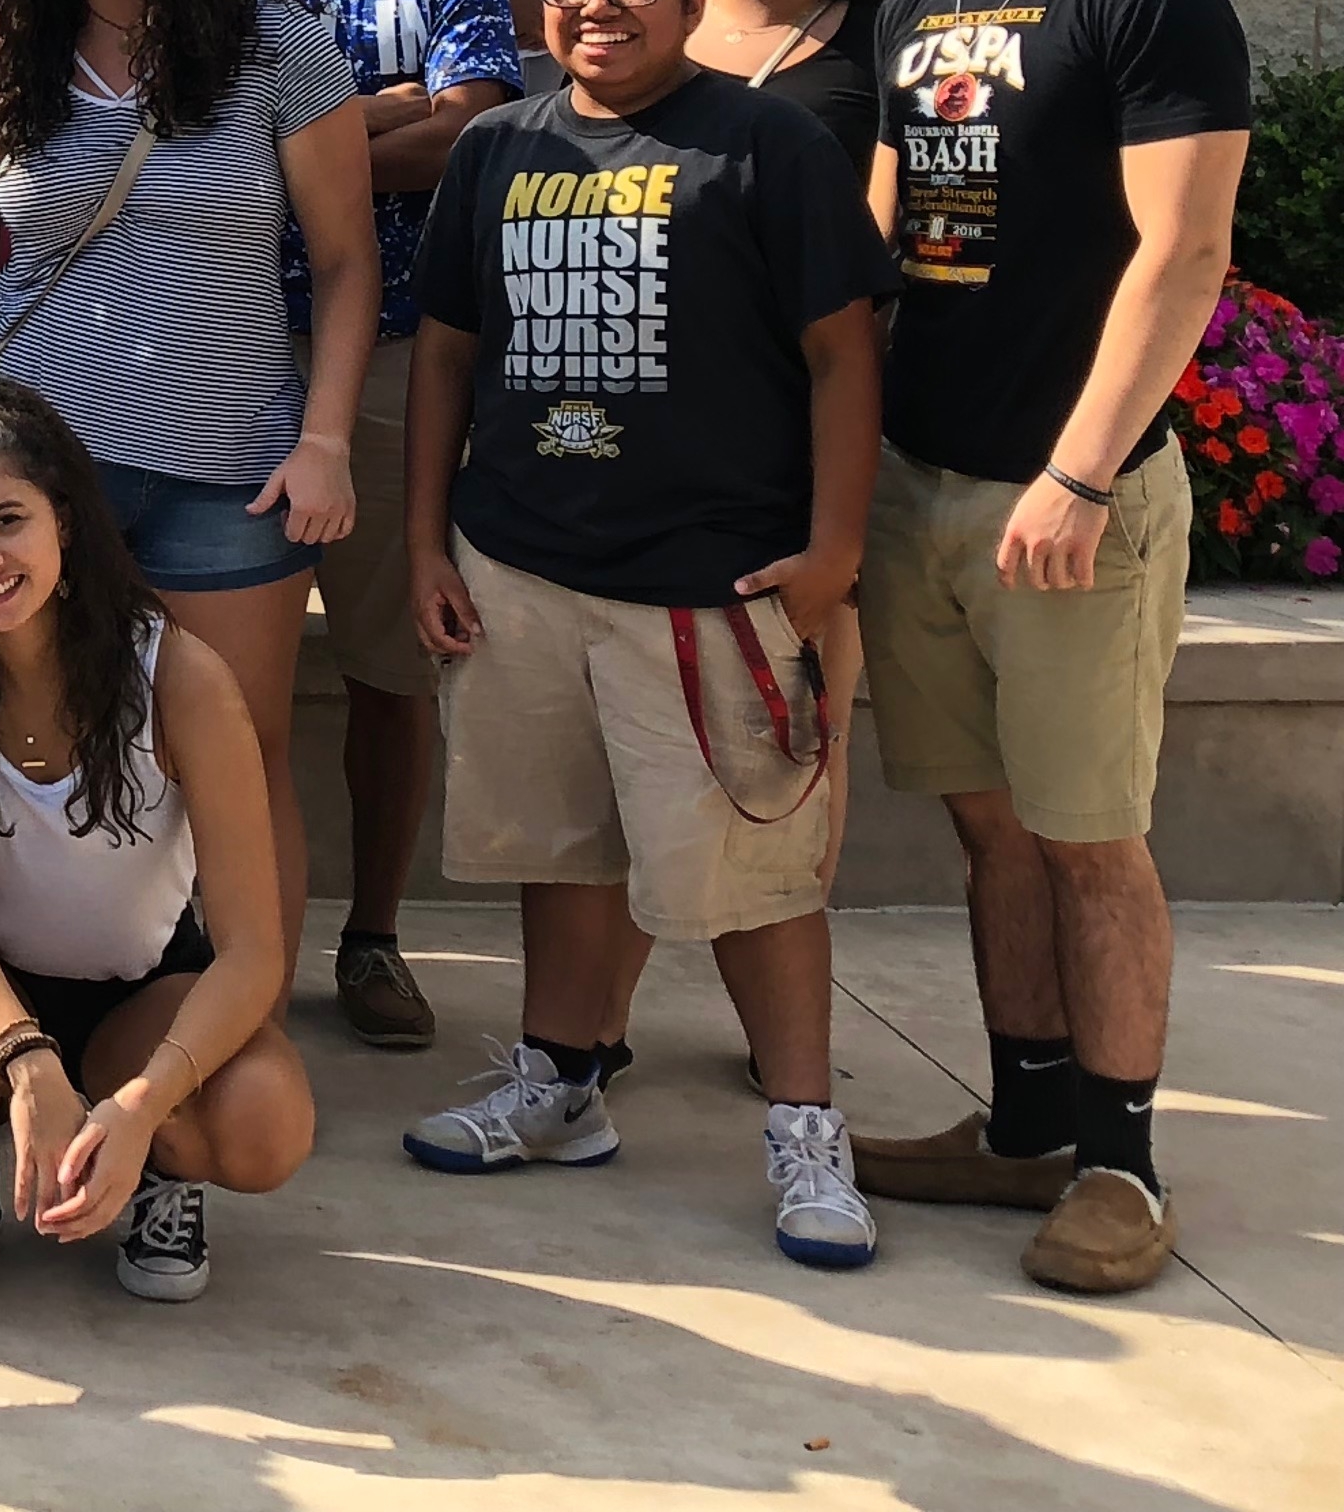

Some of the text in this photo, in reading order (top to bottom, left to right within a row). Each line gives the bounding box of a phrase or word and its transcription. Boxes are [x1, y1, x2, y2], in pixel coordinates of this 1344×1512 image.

[896, 25, 1026, 91] USPA
[904, 137, 1000, 173] BASH
[503, 165, 679, 219] NORSE
